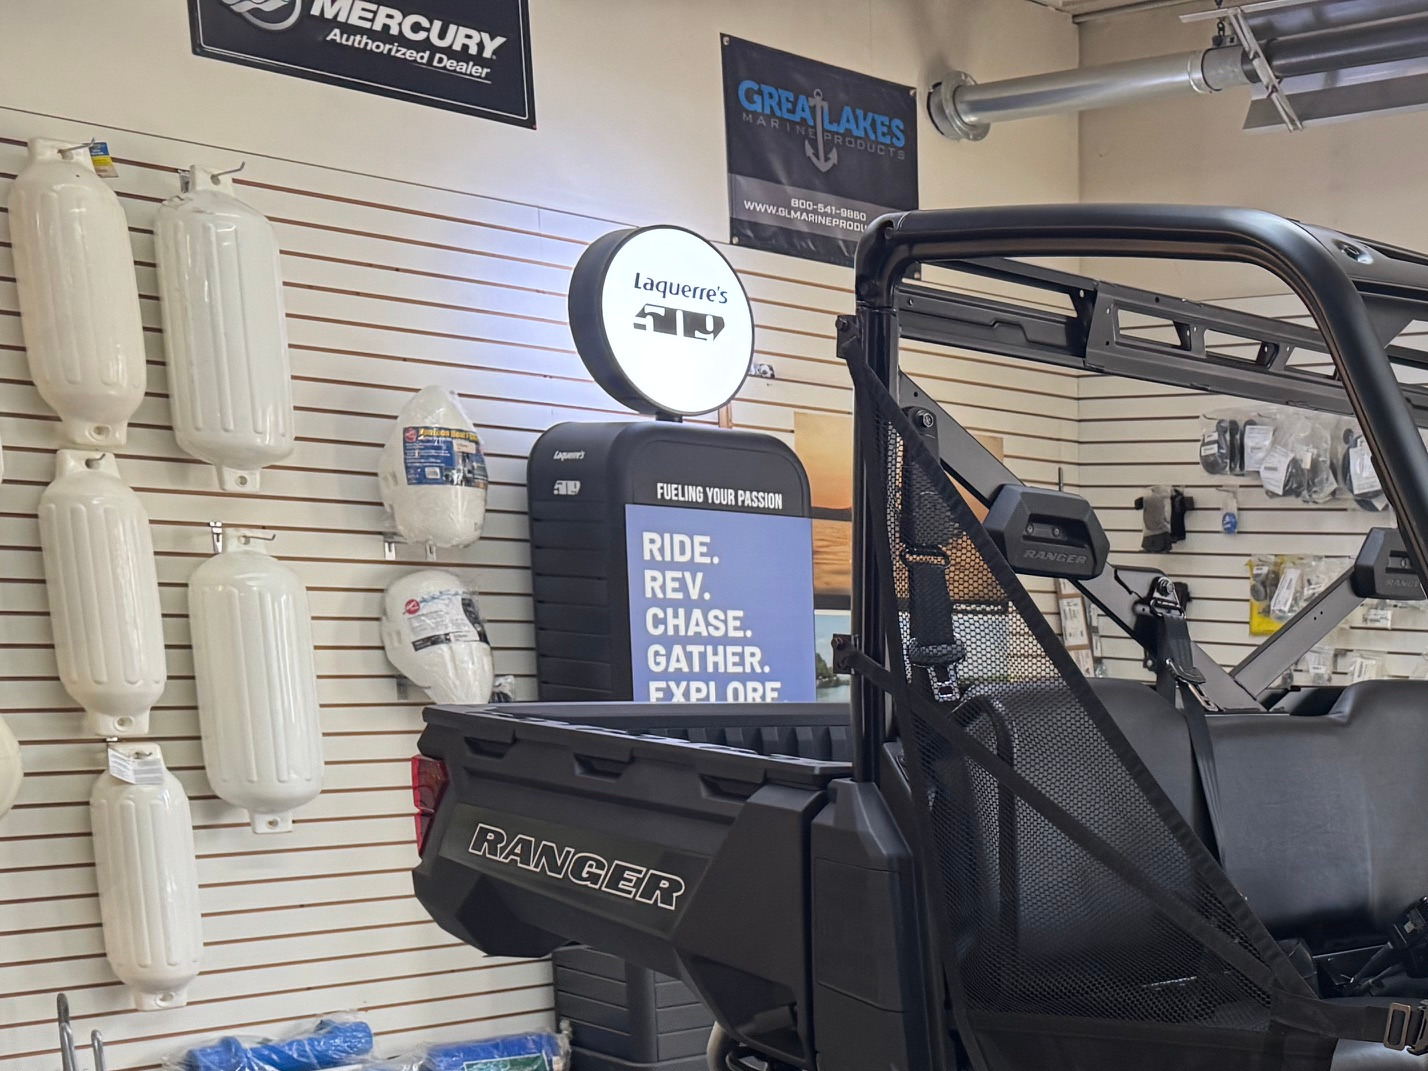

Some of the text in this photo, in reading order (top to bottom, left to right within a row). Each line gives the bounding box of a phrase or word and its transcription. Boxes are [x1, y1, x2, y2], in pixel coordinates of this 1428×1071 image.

[310, 0, 507, 59] MERCURY
[326, 28, 491, 79] Authorized Dealer
[742, 112, 905, 160] MARINE PRODUCTS
[823, 104, 906, 148] LAKES
[744, 200, 867, 233] WWW.GLMARINEPRODU
[634, 272, 729, 304] Laquerre's
[656, 483, 783, 510] FUELING YOUR PASSION
[642, 531, 720, 565] RIDE.
[1023, 549, 1087, 564] RANGER
[644, 569, 711, 600] REV.
[645, 606, 752, 638] CHASE.
[647, 644, 770, 674] GATHER.
[468, 823, 686, 911] RANGER
